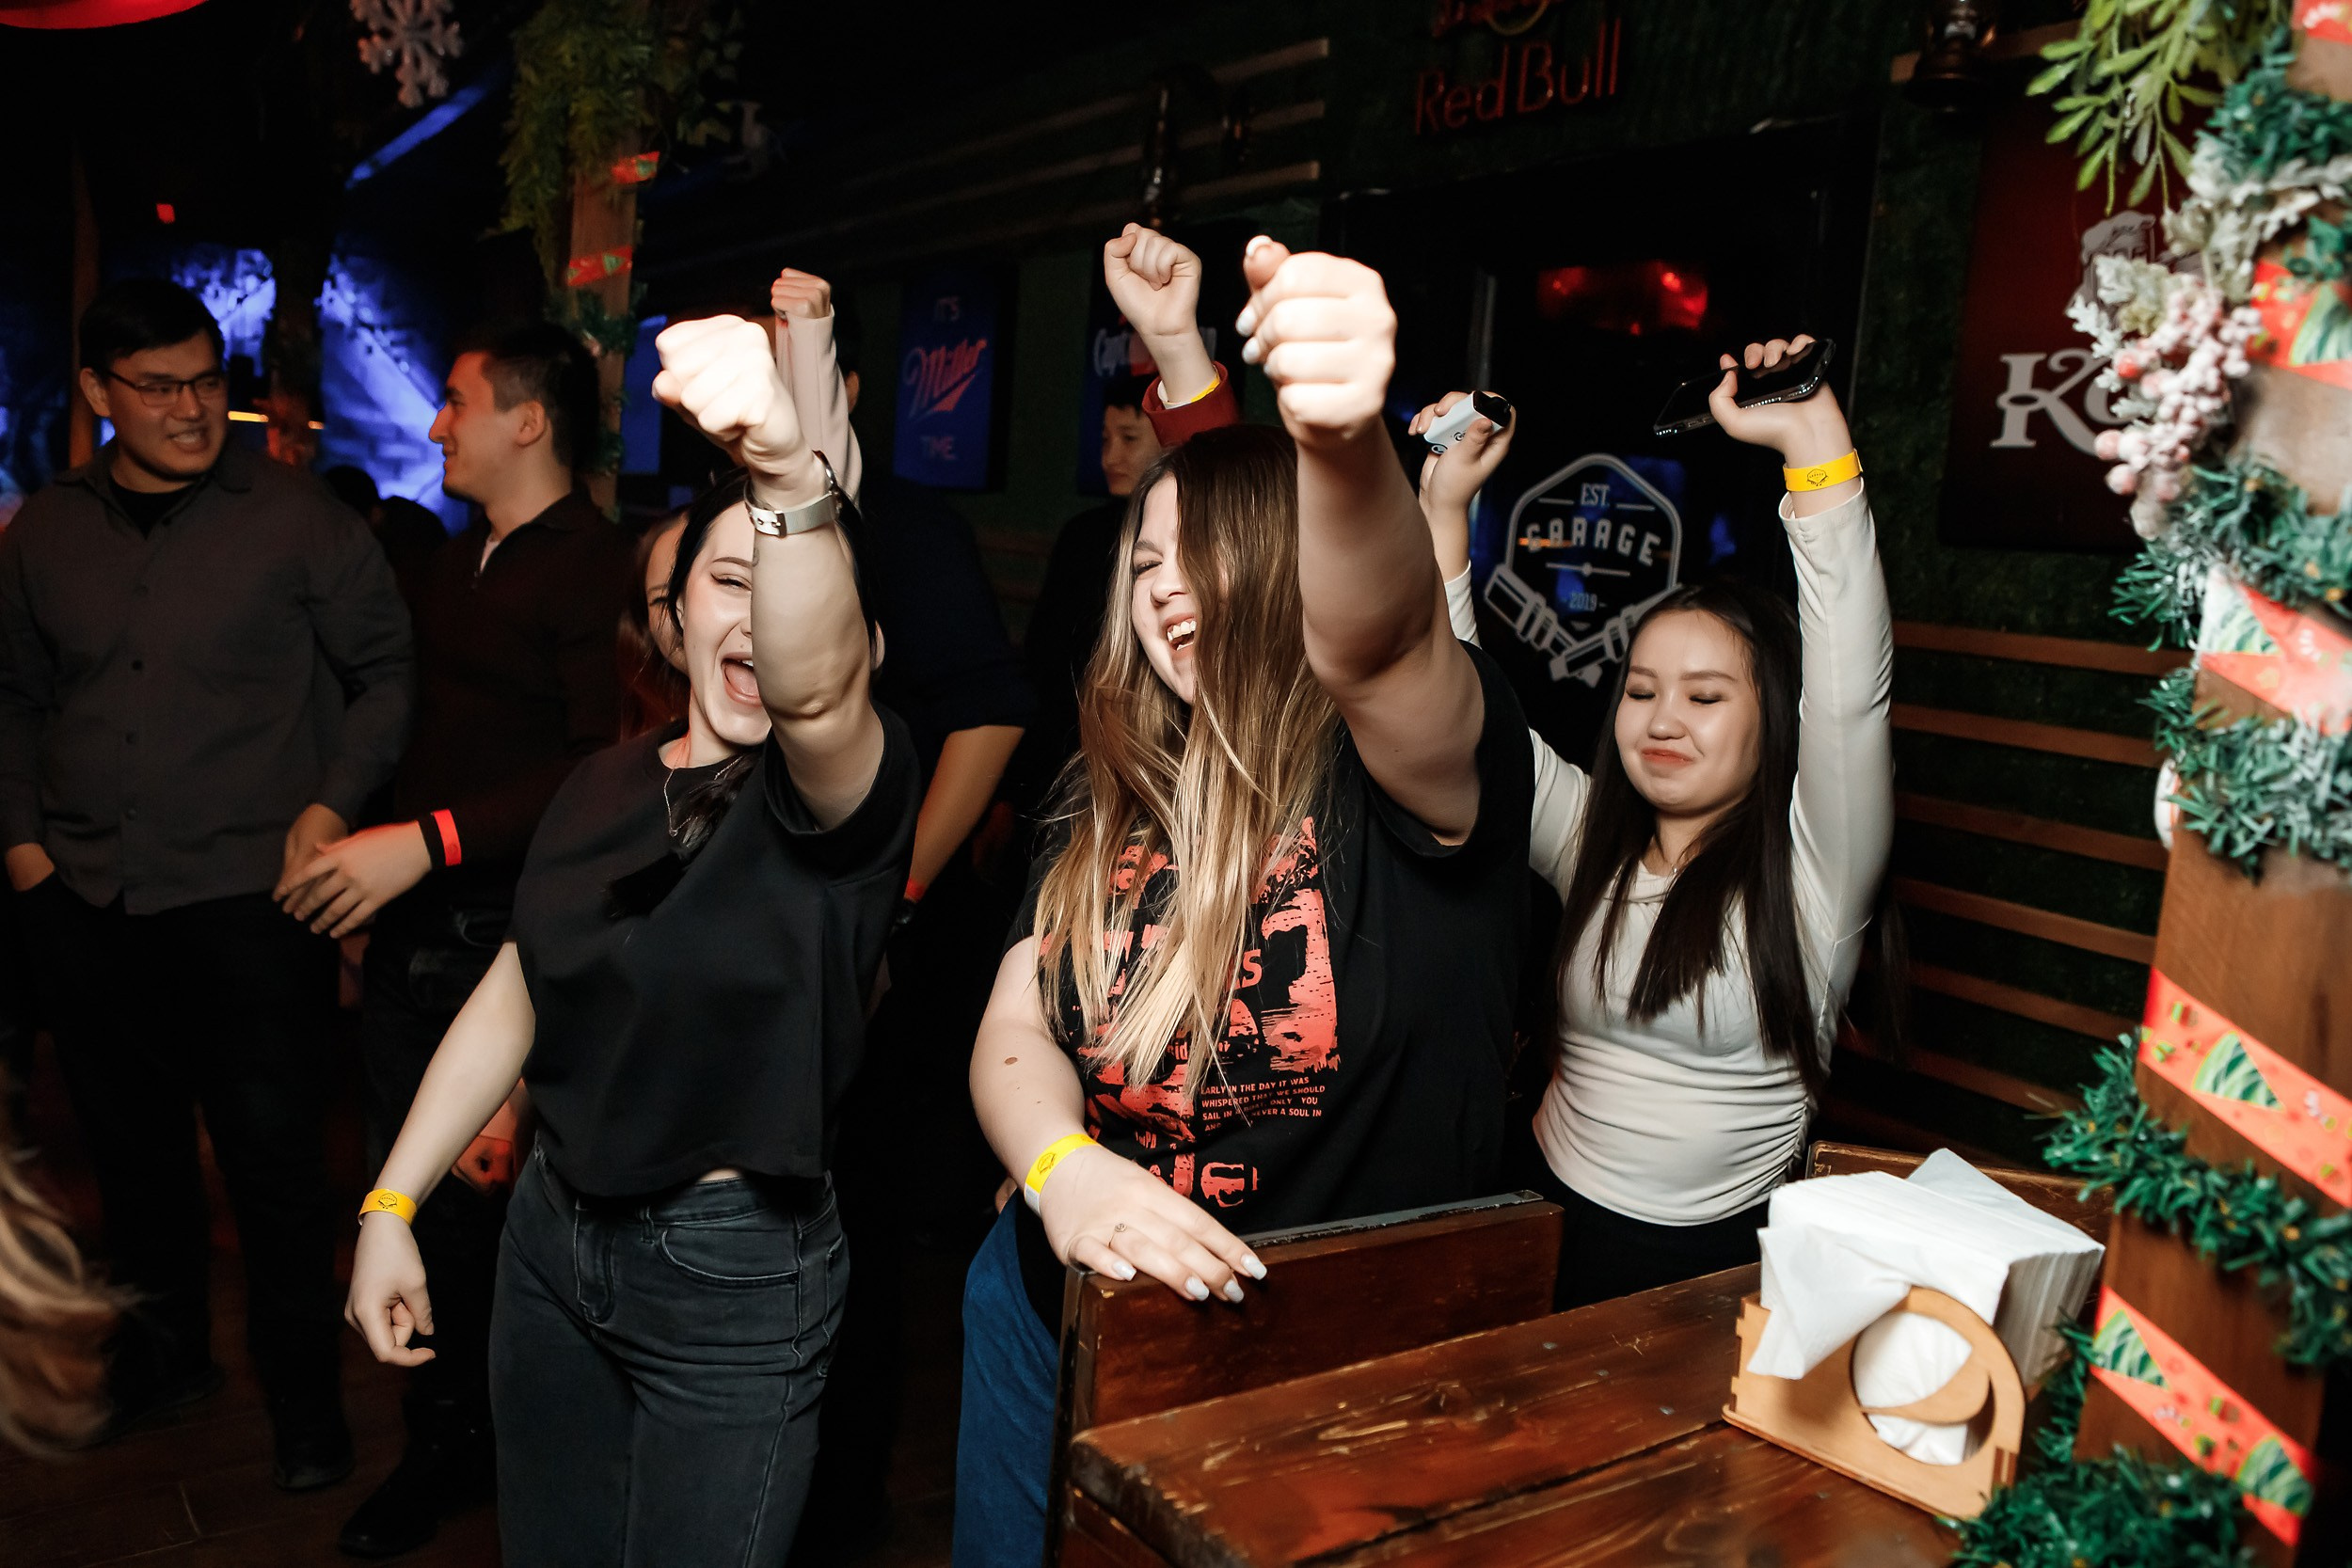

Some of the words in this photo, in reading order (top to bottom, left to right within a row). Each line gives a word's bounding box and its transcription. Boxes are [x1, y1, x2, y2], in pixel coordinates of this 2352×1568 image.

[1415, 43, 1509, 135] Red
[1516, 16, 1622, 114] Bull
[902, 338, 987, 420] Miller
[1525, 518, 1661, 566] GARAGE
[1569, 592, 1598, 612] 2019
[1201, 1097, 1249, 1108] WHISPERED
[1292, 1085, 1326, 1095] SHOULD
[1240, 1084, 1256, 1093] THE
[1259, 1081, 1277, 1091] DAY
[1291, 1076, 1310, 1085] WAS
[1202, 1112, 1221, 1121] SAIL
[1223, 1110, 1232, 1118] IN
[1301, 1096, 1318, 1105] YOU
[1288, 1108, 1310, 1117] SOUL
[1311, 1109, 1322, 1117] IN
